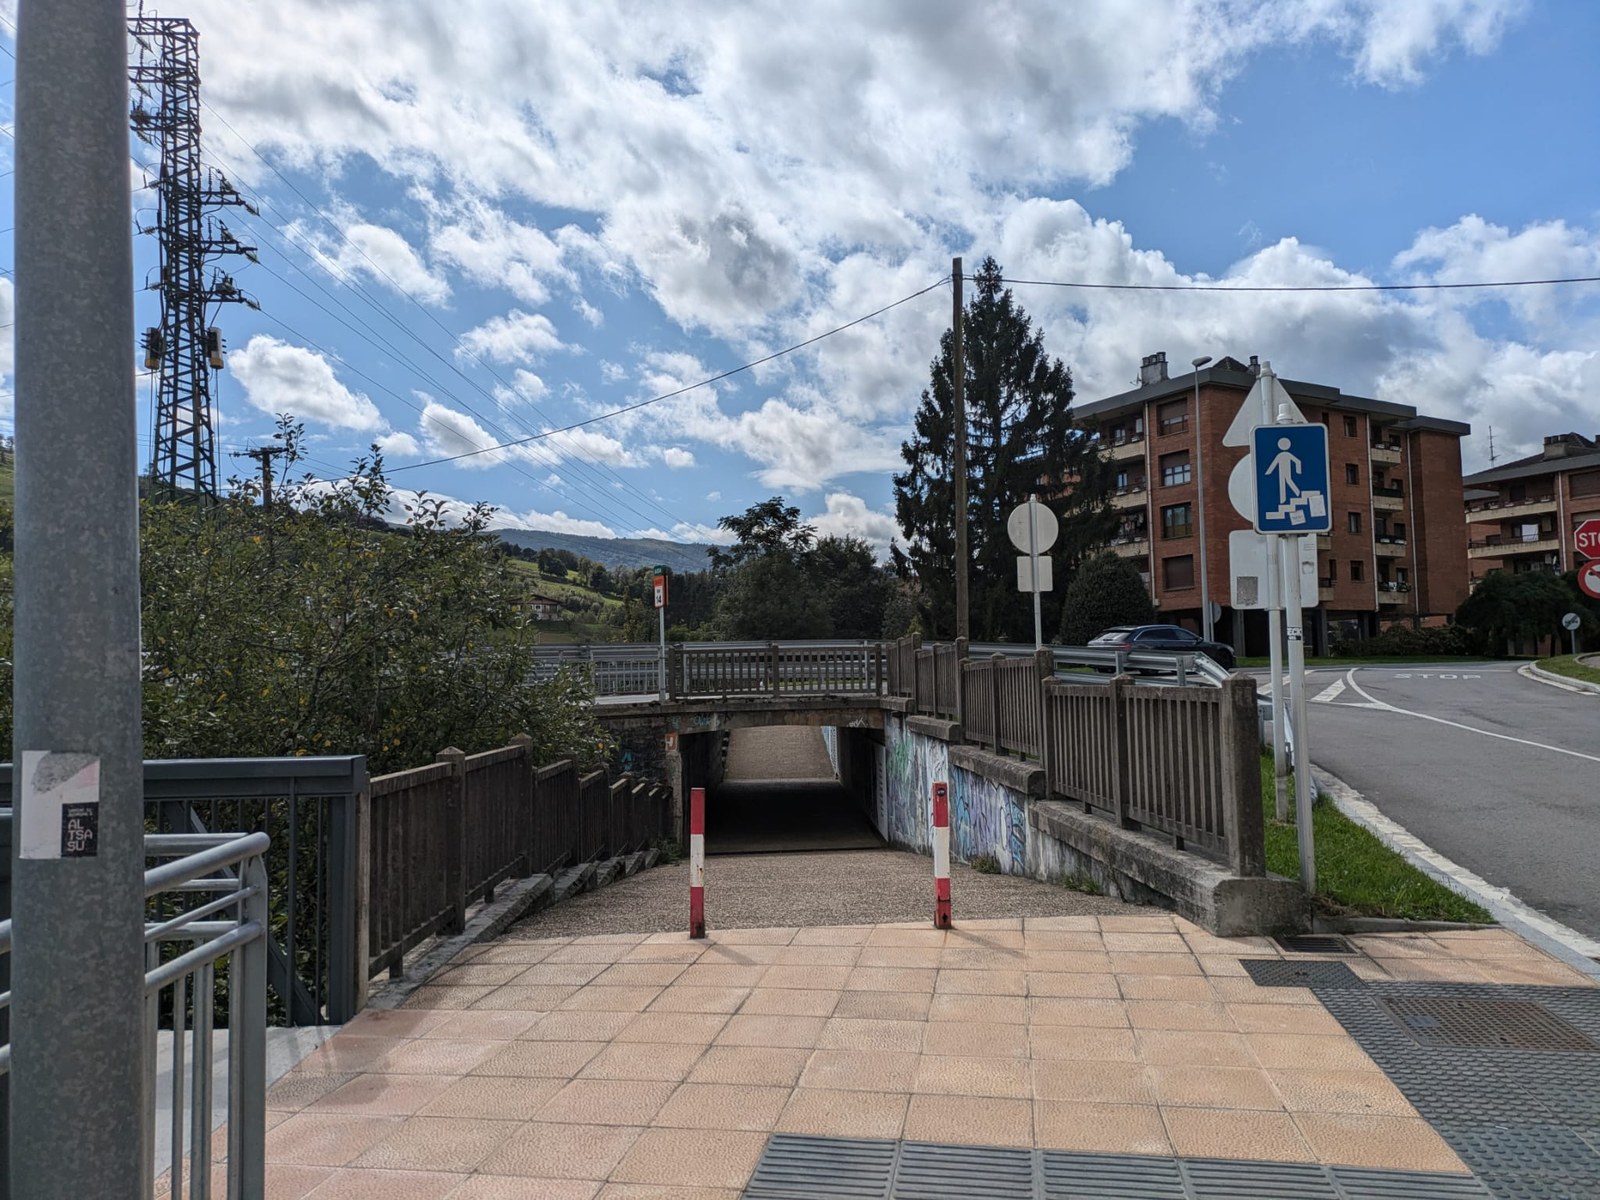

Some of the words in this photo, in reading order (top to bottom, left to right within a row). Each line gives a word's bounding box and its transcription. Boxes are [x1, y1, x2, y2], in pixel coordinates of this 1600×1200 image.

[1579, 533, 1600, 547] ST
[68, 819, 84, 830] AL
[67, 829, 93, 841] TSA
[66, 840, 85, 852] SU
